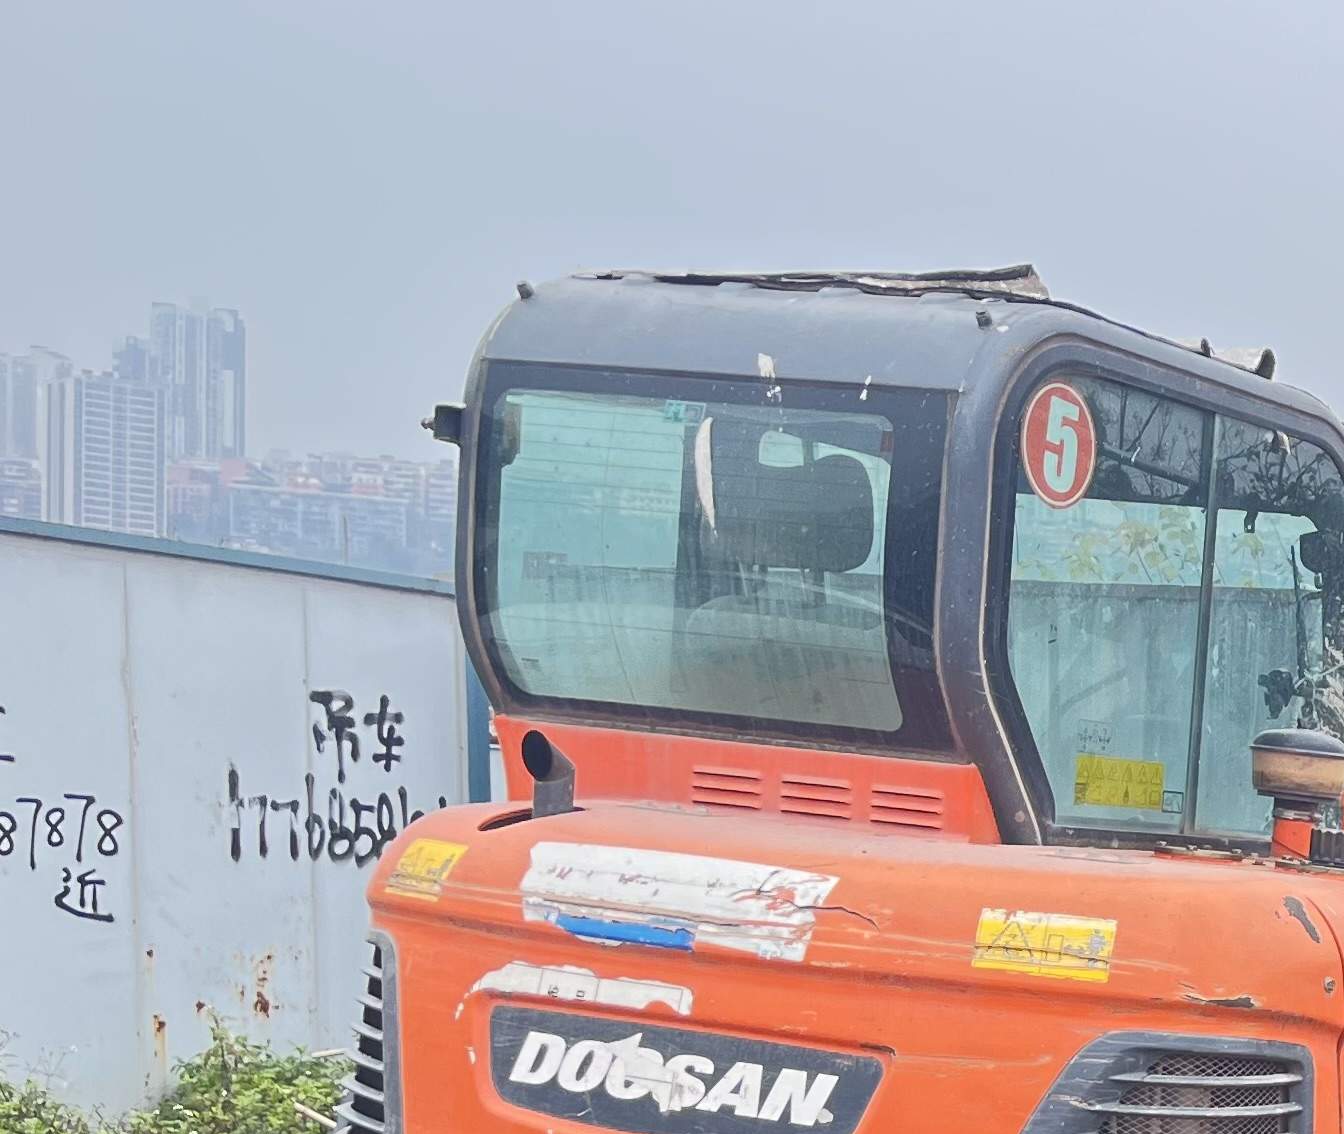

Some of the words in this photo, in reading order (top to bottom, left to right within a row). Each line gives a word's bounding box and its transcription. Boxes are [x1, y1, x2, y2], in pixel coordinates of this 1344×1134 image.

[1042, 395, 1080, 494] 5
[309, 690, 405, 784] 吊车
[55, 867, 114, 922] 近
